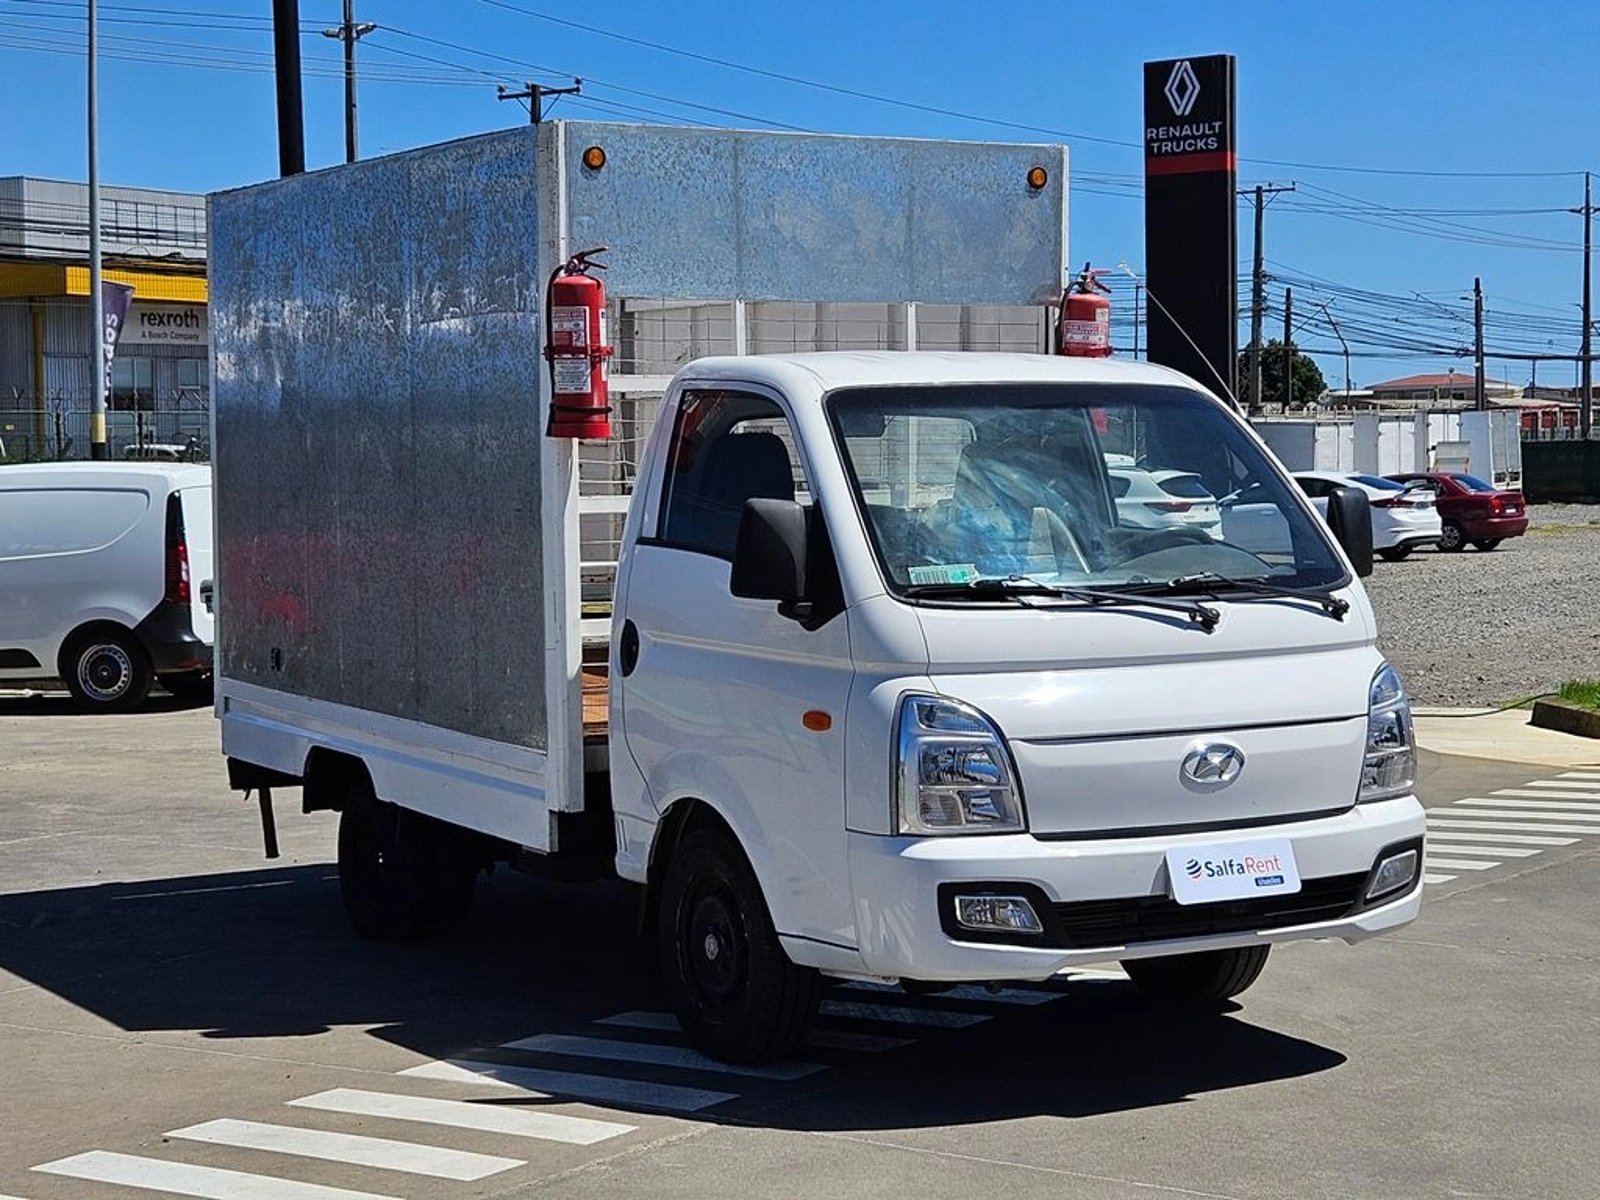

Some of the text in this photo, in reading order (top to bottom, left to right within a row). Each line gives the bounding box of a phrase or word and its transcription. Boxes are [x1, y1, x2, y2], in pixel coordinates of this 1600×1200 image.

[1147, 121, 1222, 139] RENAULT
[1151, 137, 1217, 154] TRUCKS
[140, 309, 199, 328] rexroth
[148, 331, 168, 339] Bosch
[170, 331, 199, 341] Company
[1204, 854, 1282, 878] SalfaRent
